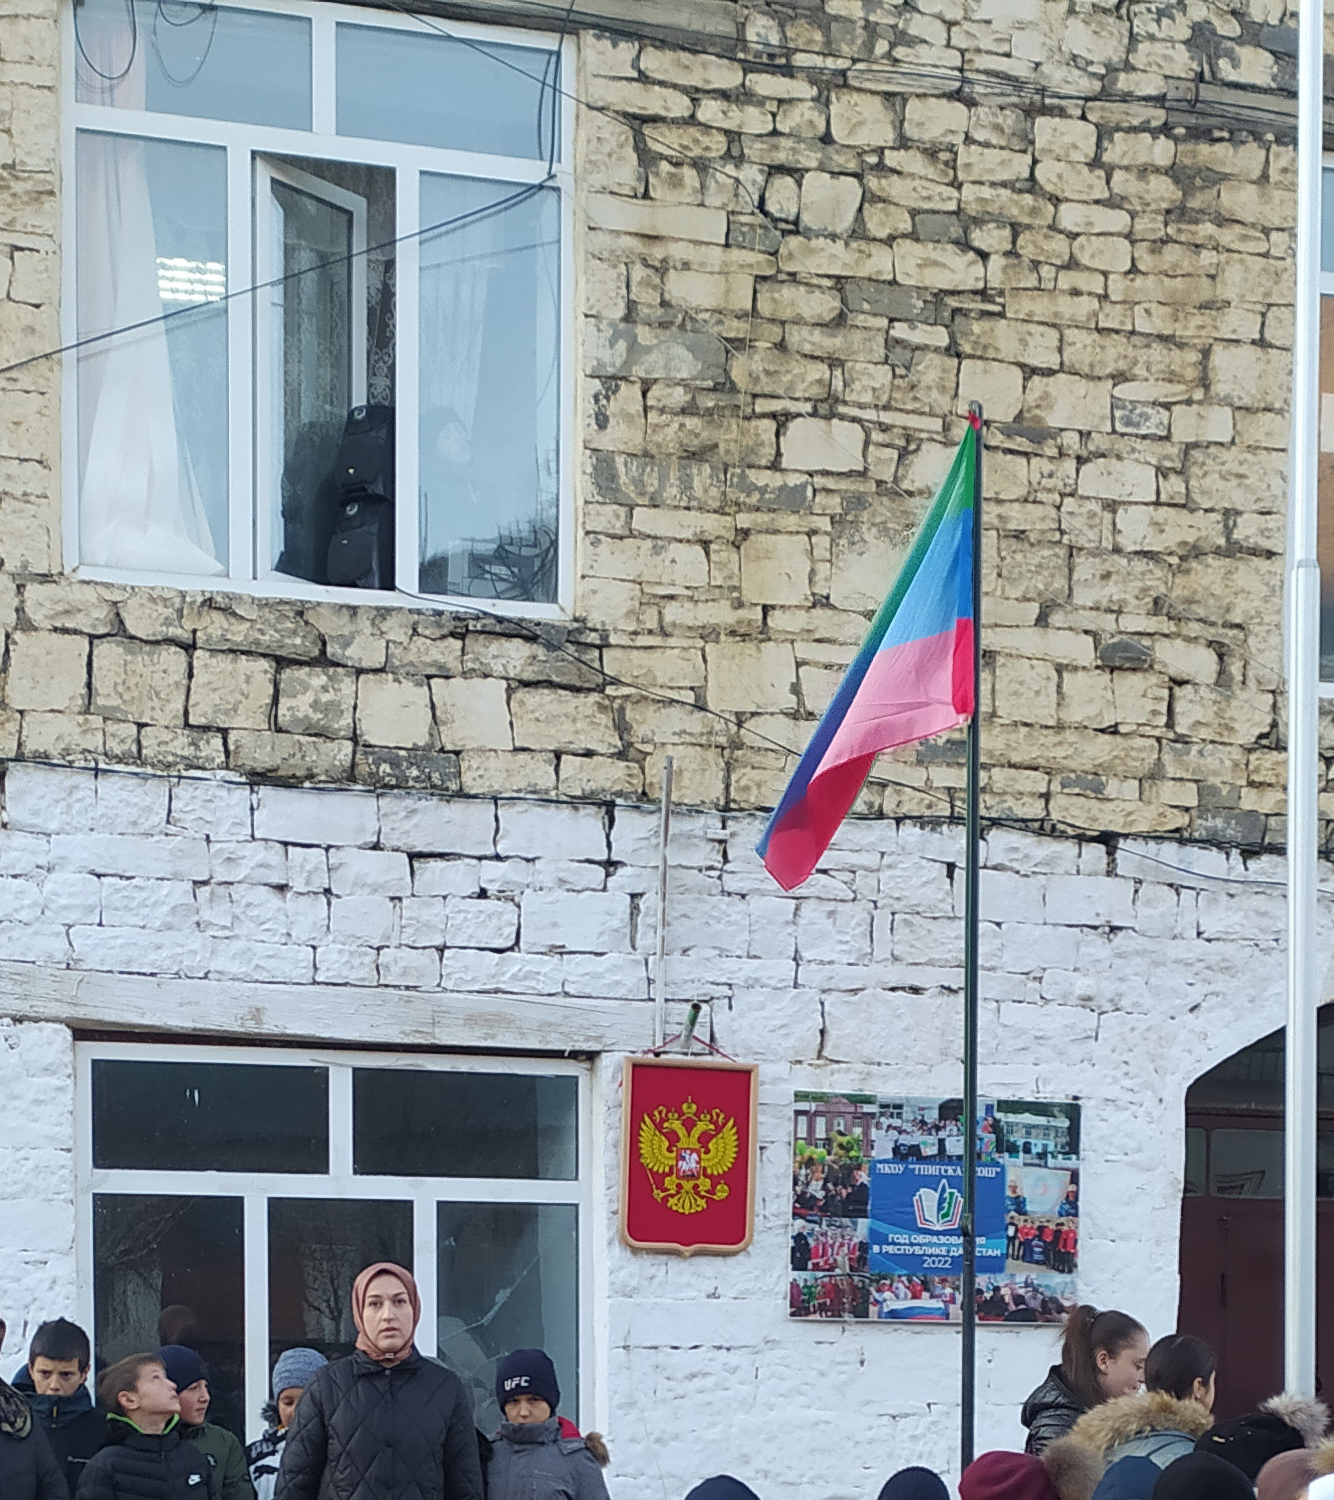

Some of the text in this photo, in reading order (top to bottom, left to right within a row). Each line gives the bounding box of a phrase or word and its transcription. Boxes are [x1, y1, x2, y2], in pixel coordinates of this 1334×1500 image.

[876, 1163, 906, 1174] МКОУ
[888, 1234, 910, 1244] ГОД
[872, 1245, 1001, 1257] В РЕСПУБЛИКЕ ДАСТАН
[922, 1256, 952, 1268] 2022
[504, 1376, 530, 1391] UFC
